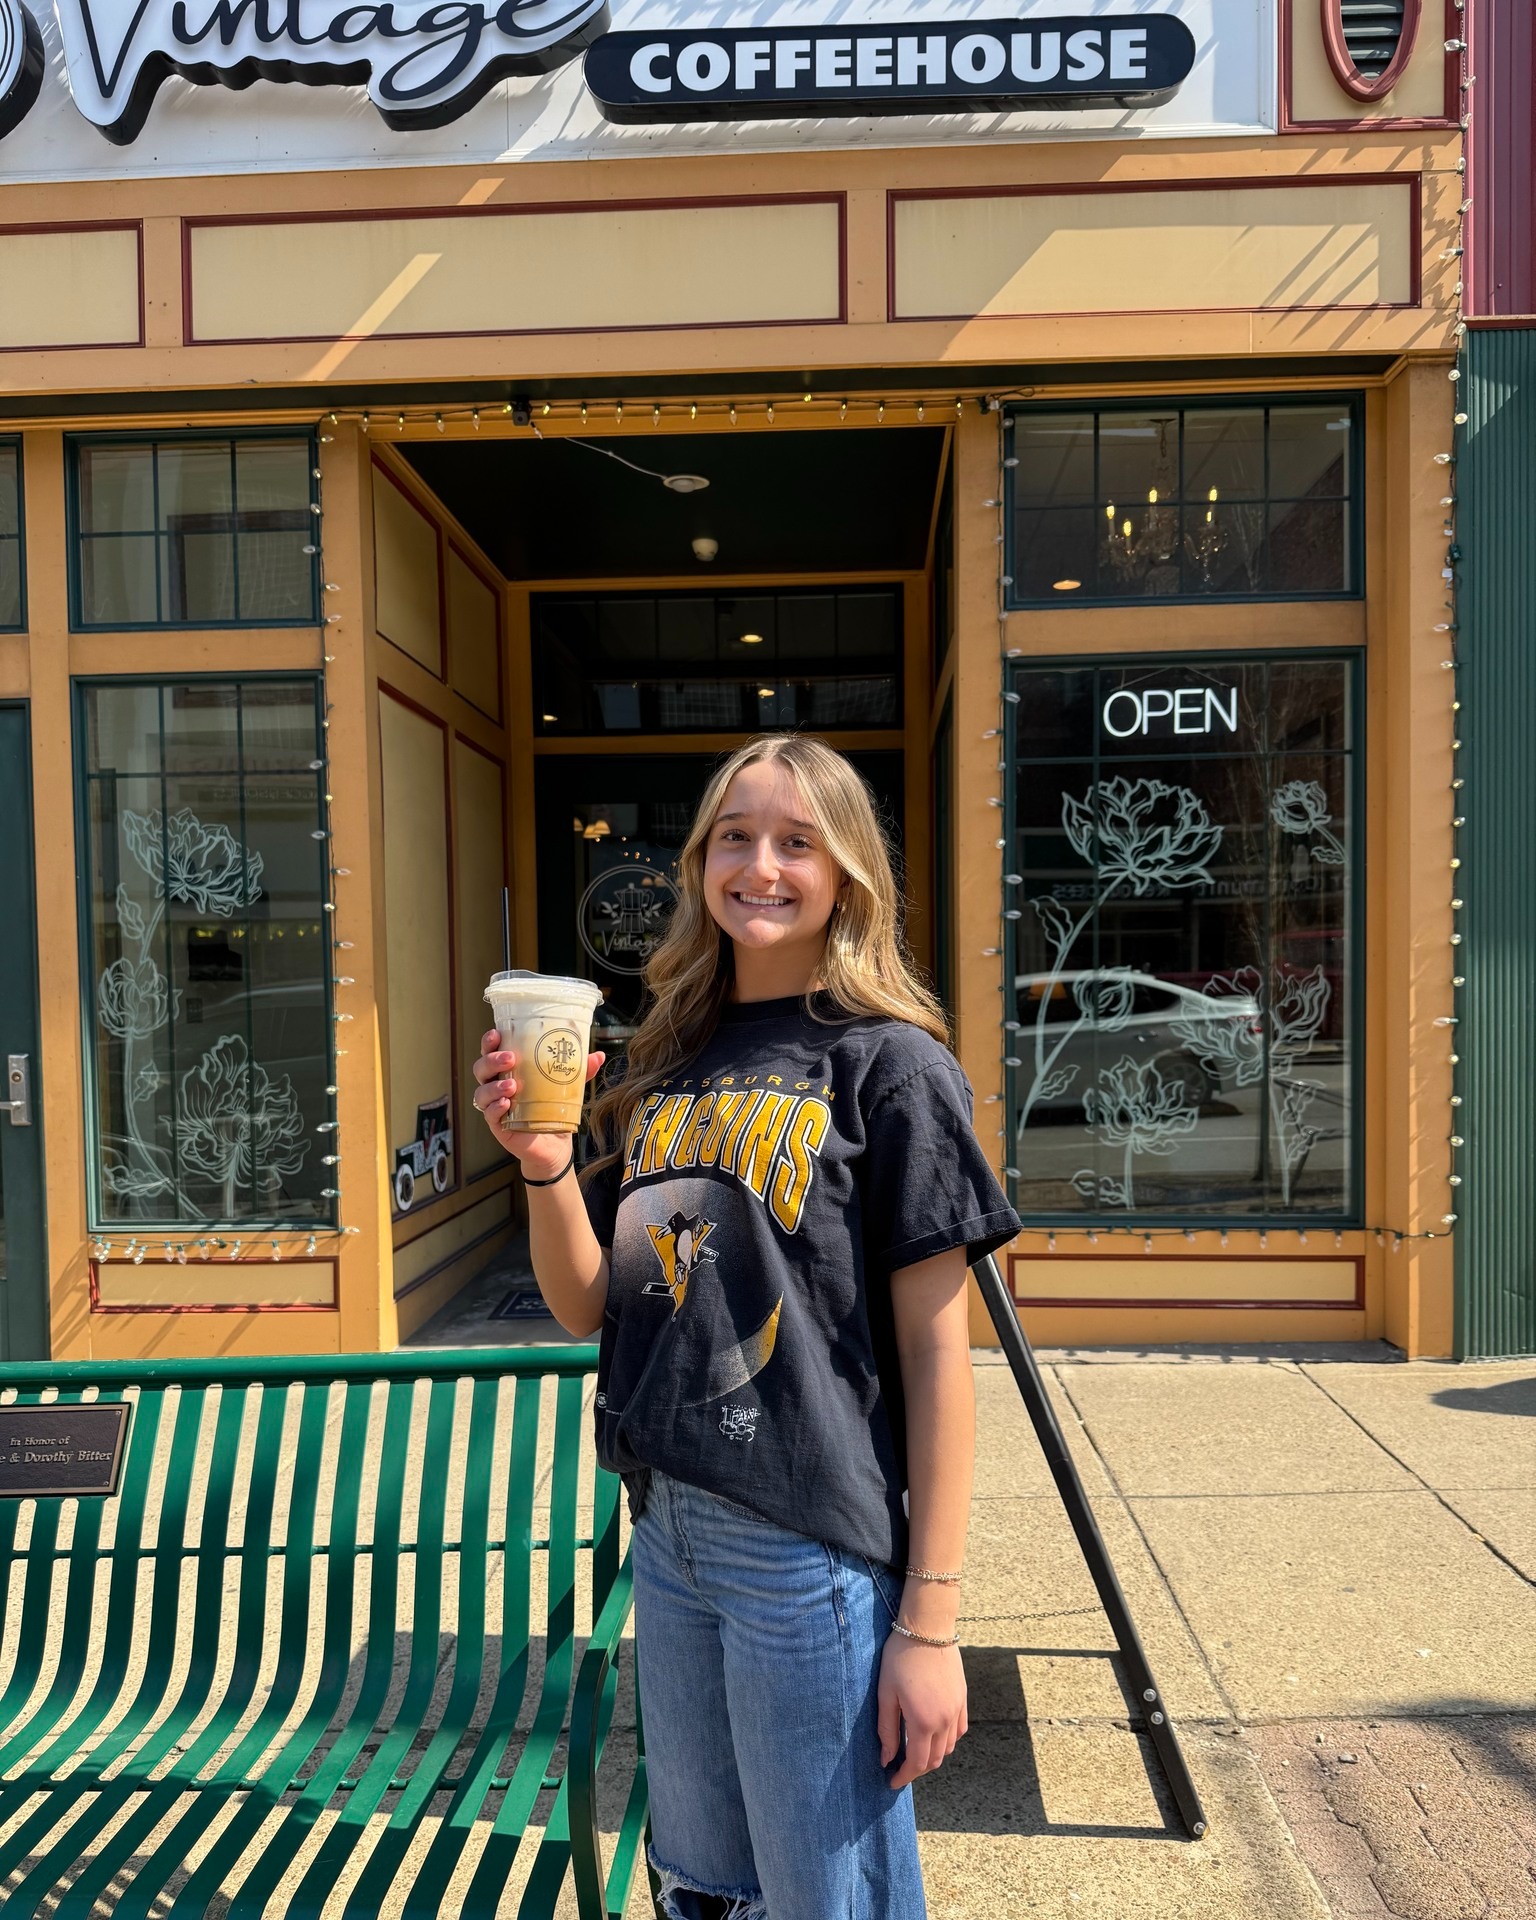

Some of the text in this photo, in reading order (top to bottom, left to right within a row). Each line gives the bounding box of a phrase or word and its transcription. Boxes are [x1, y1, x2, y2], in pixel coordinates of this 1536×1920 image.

[629, 28, 1148, 93] COFFEEHOUSE
[1103, 687, 1237, 738] OPEN
[601, 929, 662, 957] Vintage
[547, 1061, 577, 1076] Vintage
[661, 1074, 836, 1101] TTSBURGH
[621, 1089, 831, 1235] ENGUINS
[9, 1435, 71, 1446] In Honor of
[9, 1452, 20, 1463] &
[24, 1450, 75, 1464] Dorothy
[78, 1450, 112, 1461] Bitter
